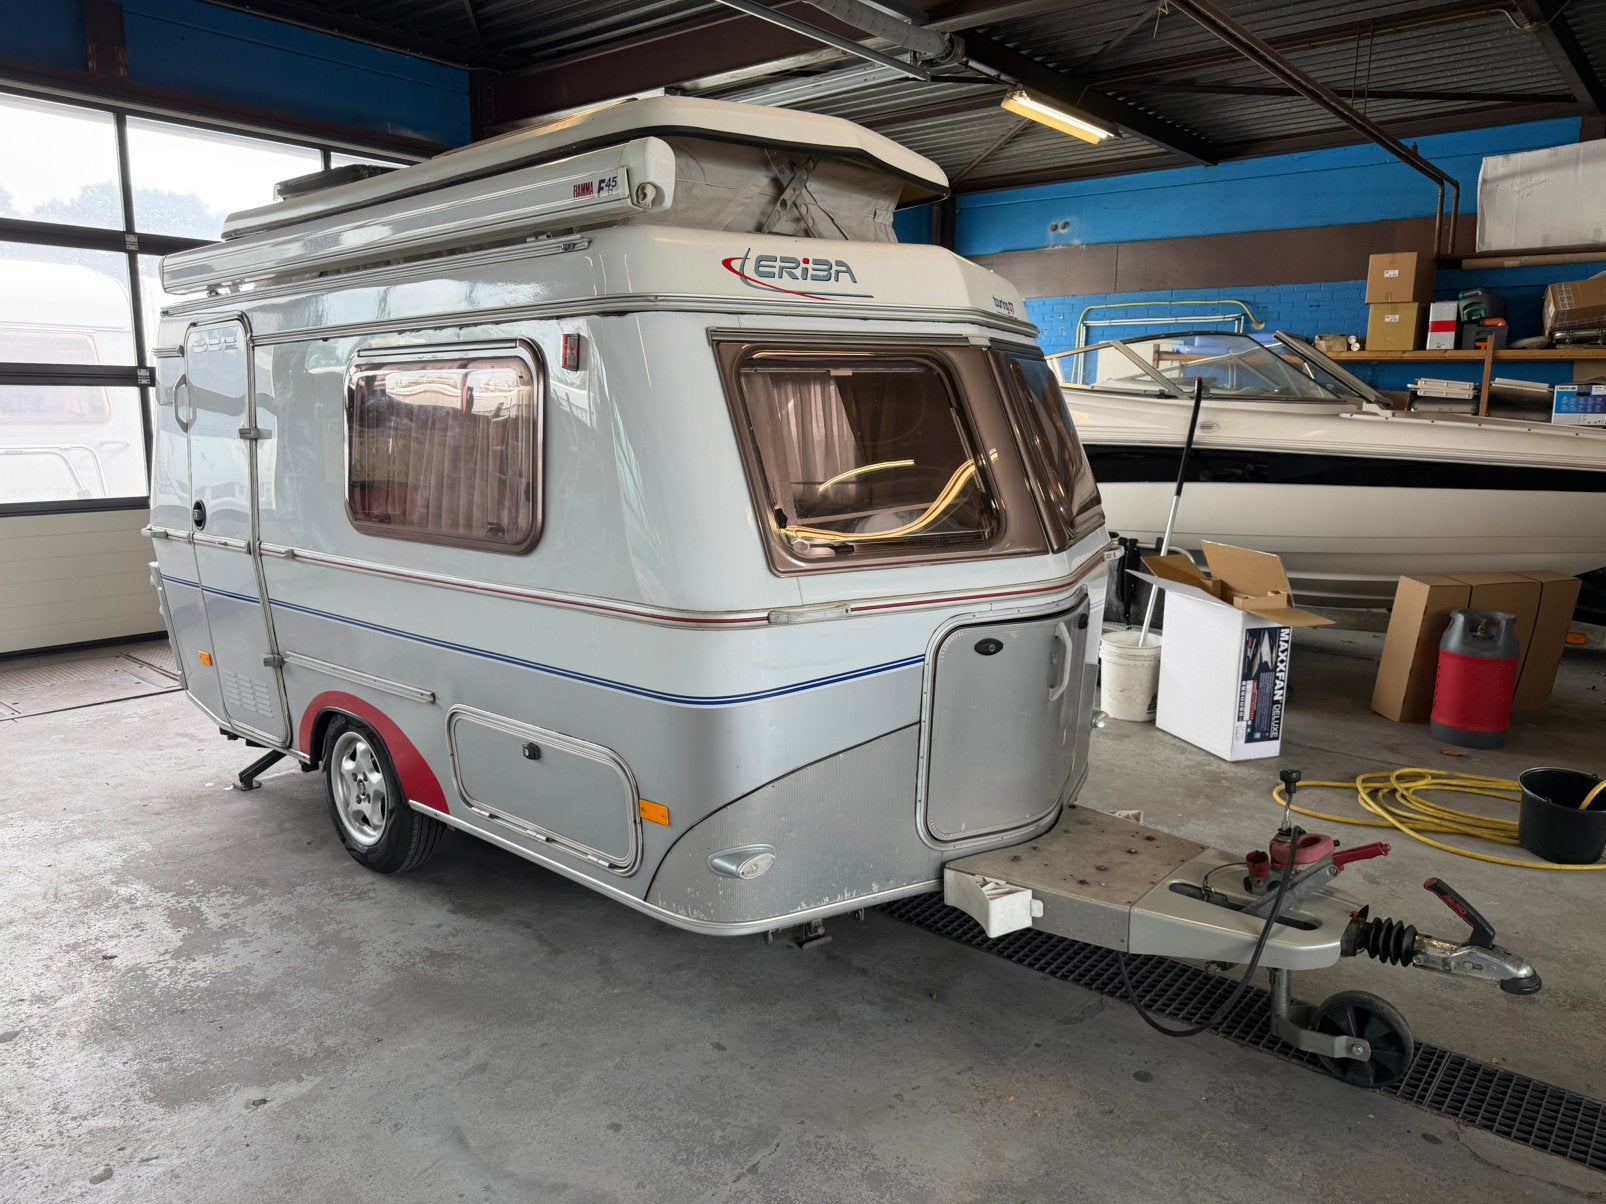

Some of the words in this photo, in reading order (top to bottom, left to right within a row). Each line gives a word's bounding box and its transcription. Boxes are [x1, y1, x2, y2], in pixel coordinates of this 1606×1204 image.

[573, 181, 594, 198] FIAMMA
[597, 176, 618, 193] F45
[1273, 629, 1290, 701] MAXXFAN
[1272, 704, 1281, 738] DELUXE
